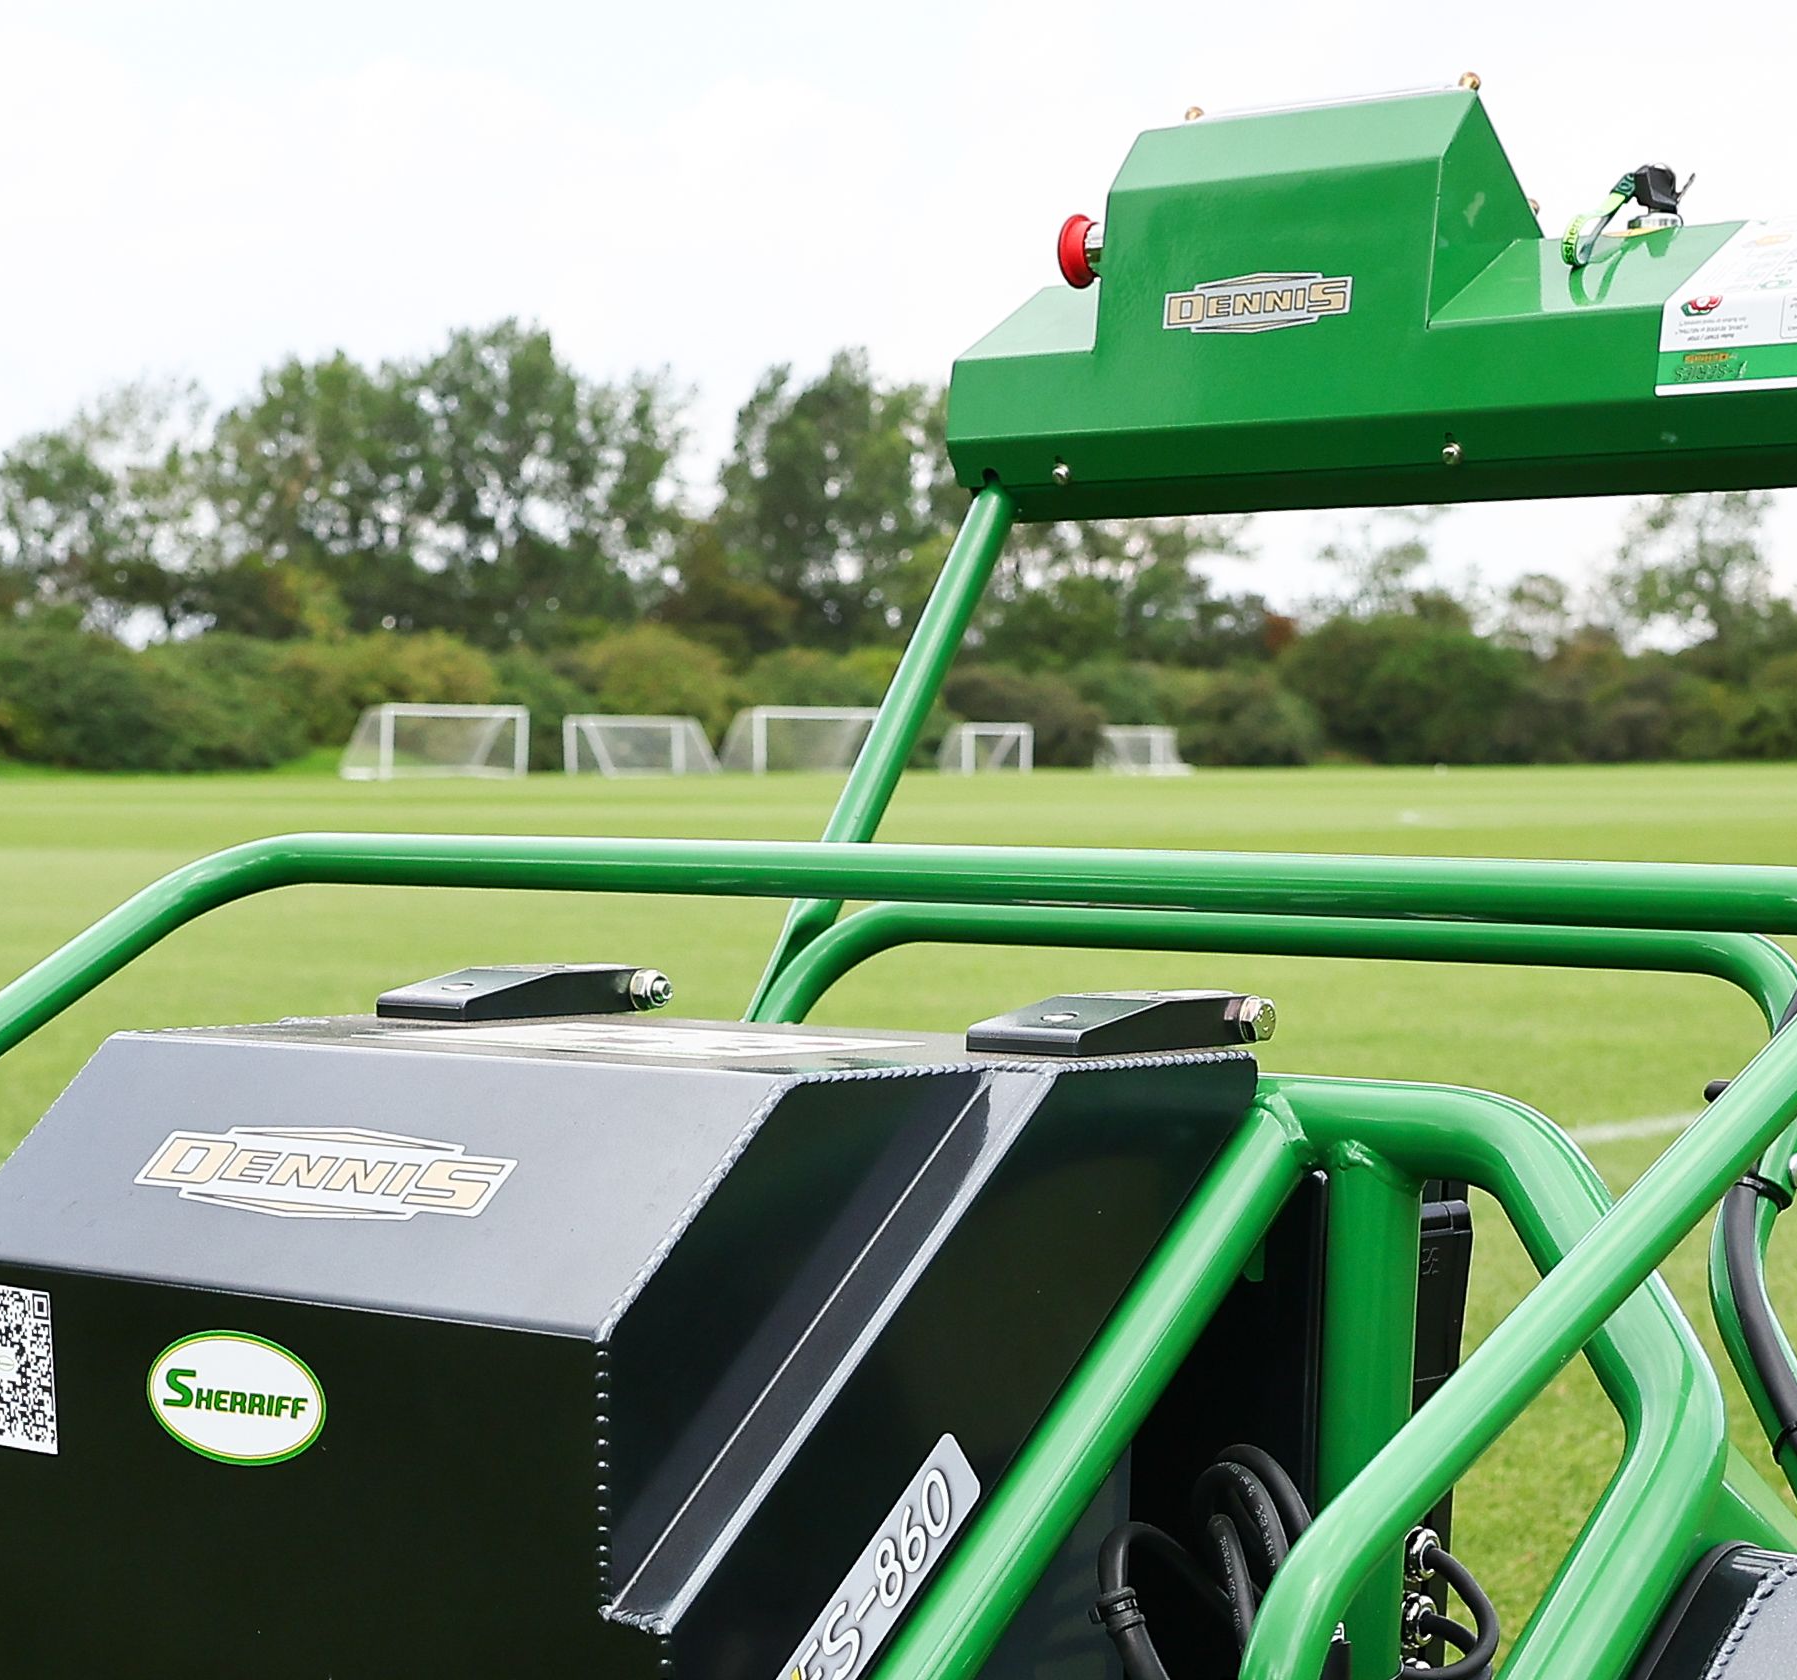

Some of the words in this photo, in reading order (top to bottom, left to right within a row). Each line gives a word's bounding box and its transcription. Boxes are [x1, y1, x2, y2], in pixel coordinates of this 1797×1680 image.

[1166, 279, 1349, 326] DENNIS
[144, 1136, 506, 1210] DENNIS
[162, 1368, 309, 1420] SHERRIFF
